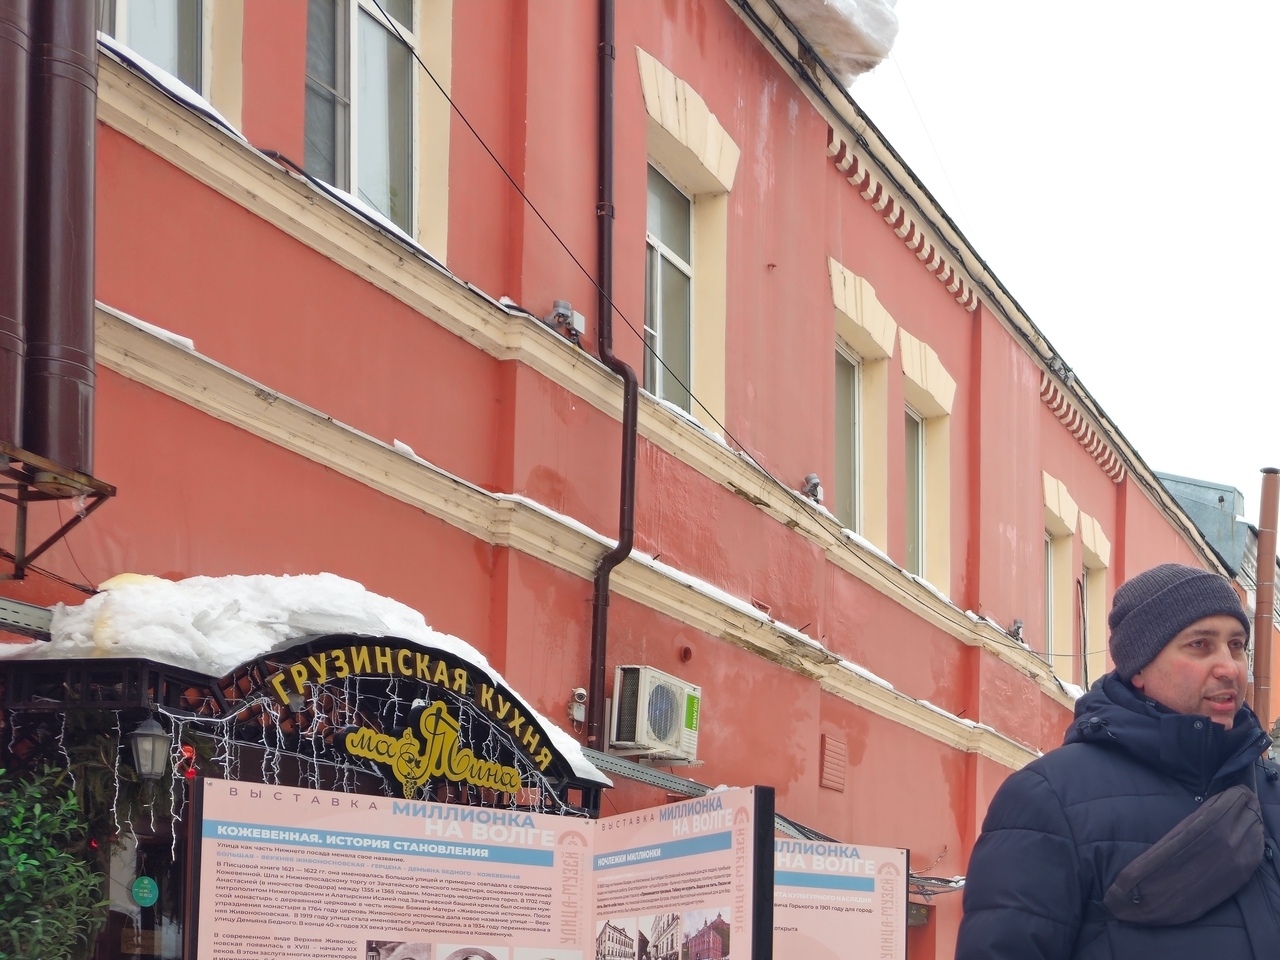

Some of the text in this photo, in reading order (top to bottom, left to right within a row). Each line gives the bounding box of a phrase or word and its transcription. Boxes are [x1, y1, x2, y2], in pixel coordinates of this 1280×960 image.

[271, 646, 554, 771] ГРУЗИНСКАЯ КУХНЯ
[229, 787, 535, 828] ВЫСТАВКА МИЛЛИОНКА
[602, 796, 723, 831] ВЫСТАВКА МИЛЛИОНКА
[425, 817, 554, 846] НА ВОЛГЕ
[672, 808, 732, 837] НА ВОЛГЕ
[217, 825, 488, 857] КОЖЕВЕННАЯ. ИСТОРИЯ СТАНОВЛЕНИЯ
[774, 840, 860, 859] ЛЛИОНКА
[597, 848, 661, 866] НОЧЛЕЖКИ МИЛЛИОНКИ
[777, 853, 875, 875] НА ВОЛГЕ
